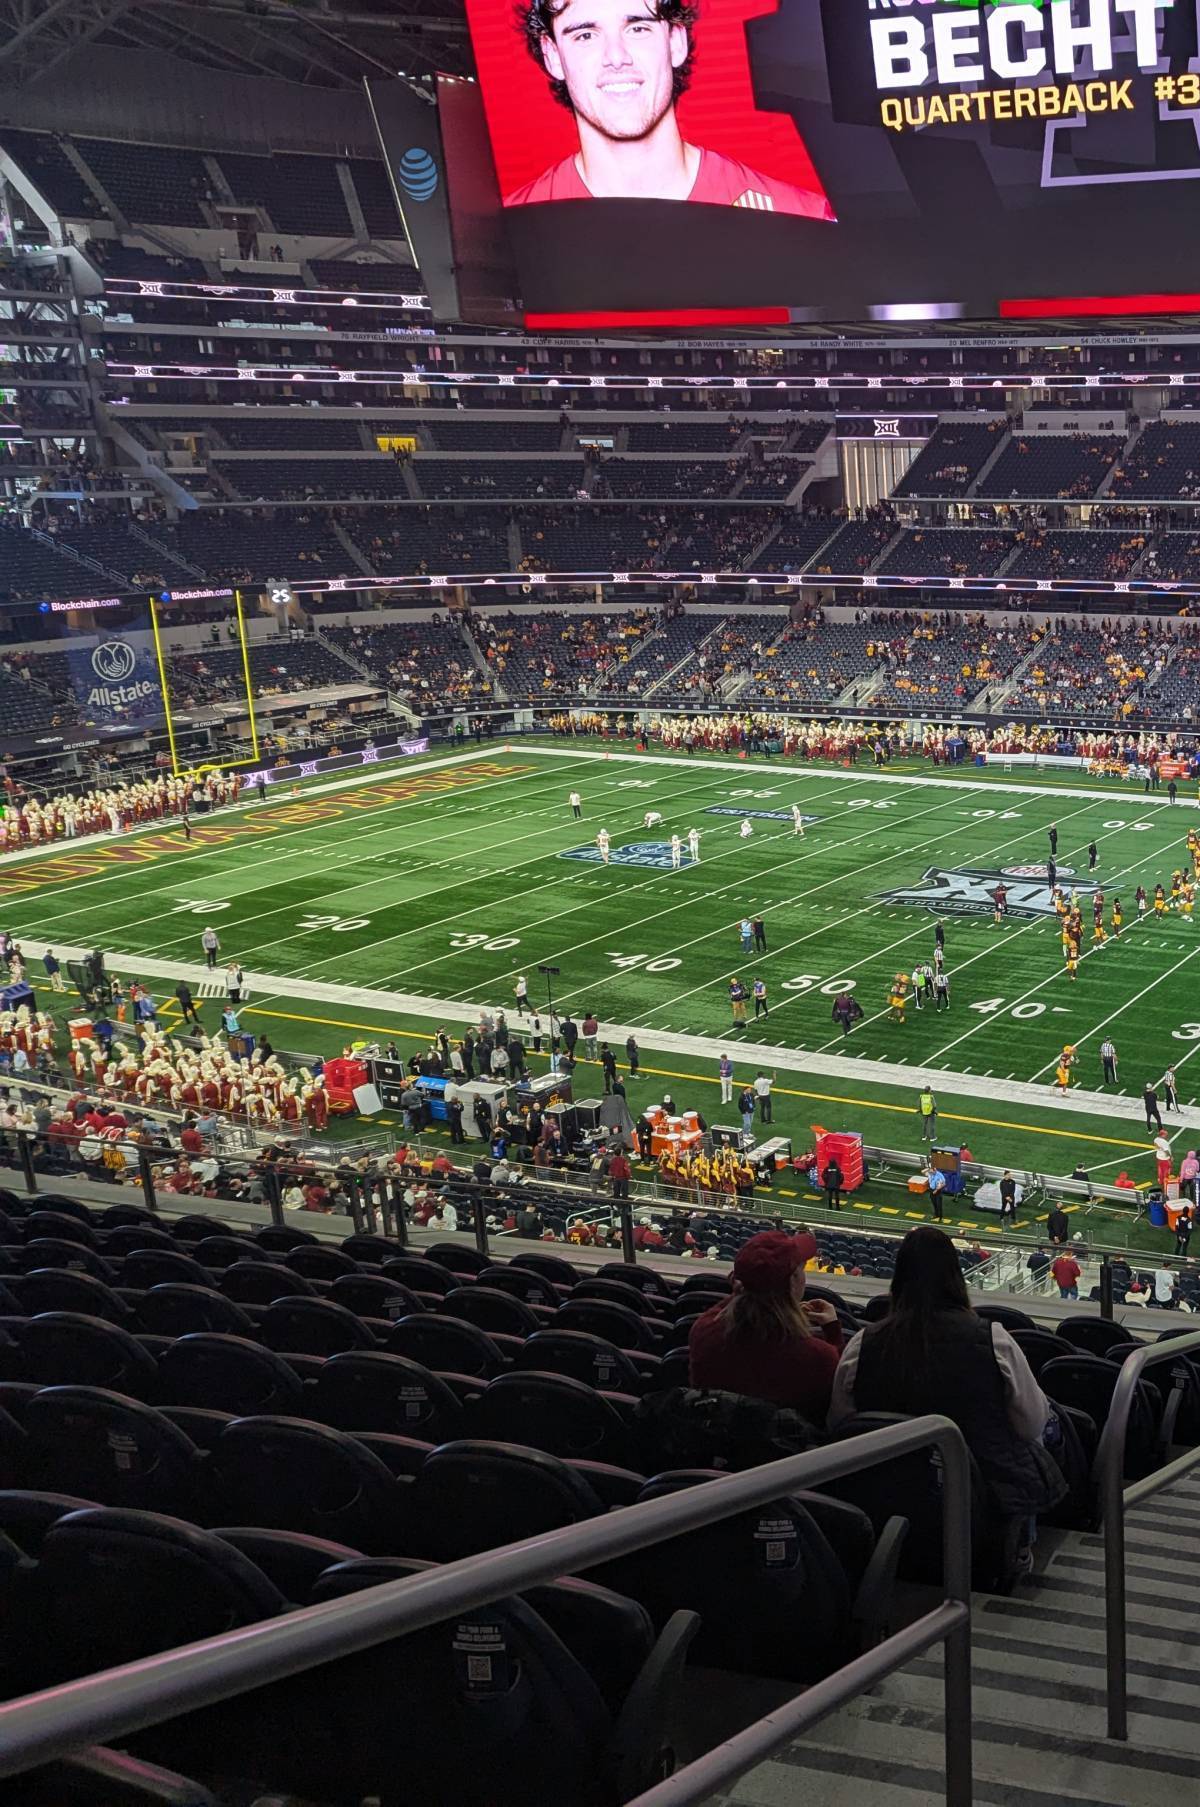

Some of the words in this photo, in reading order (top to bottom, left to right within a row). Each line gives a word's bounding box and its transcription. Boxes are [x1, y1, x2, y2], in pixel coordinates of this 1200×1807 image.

[869, 1, 1173, 89] BECHT
[881, 79, 1133, 131] QUARTERBACK
[1154, 74, 1200, 104] #3
[171, 588, 233, 600] Blockchain.com
[52, 598, 120, 612] Blockchain.com
[87, 680, 152, 706] Allstate
[245, 762, 532, 824] STATE
[846, 799, 898, 809] 30
[968, 809, 1023, 820] 40
[1102, 819, 1155, 831] 50
[184, 900, 232, 914] 10
[297, 916, 372, 932] 20
[451, 934, 521, 951] 30
[610, 954, 682, 972] 40
[781, 974, 857, 995] 50
[968, 998, 1045, 1019] 40
